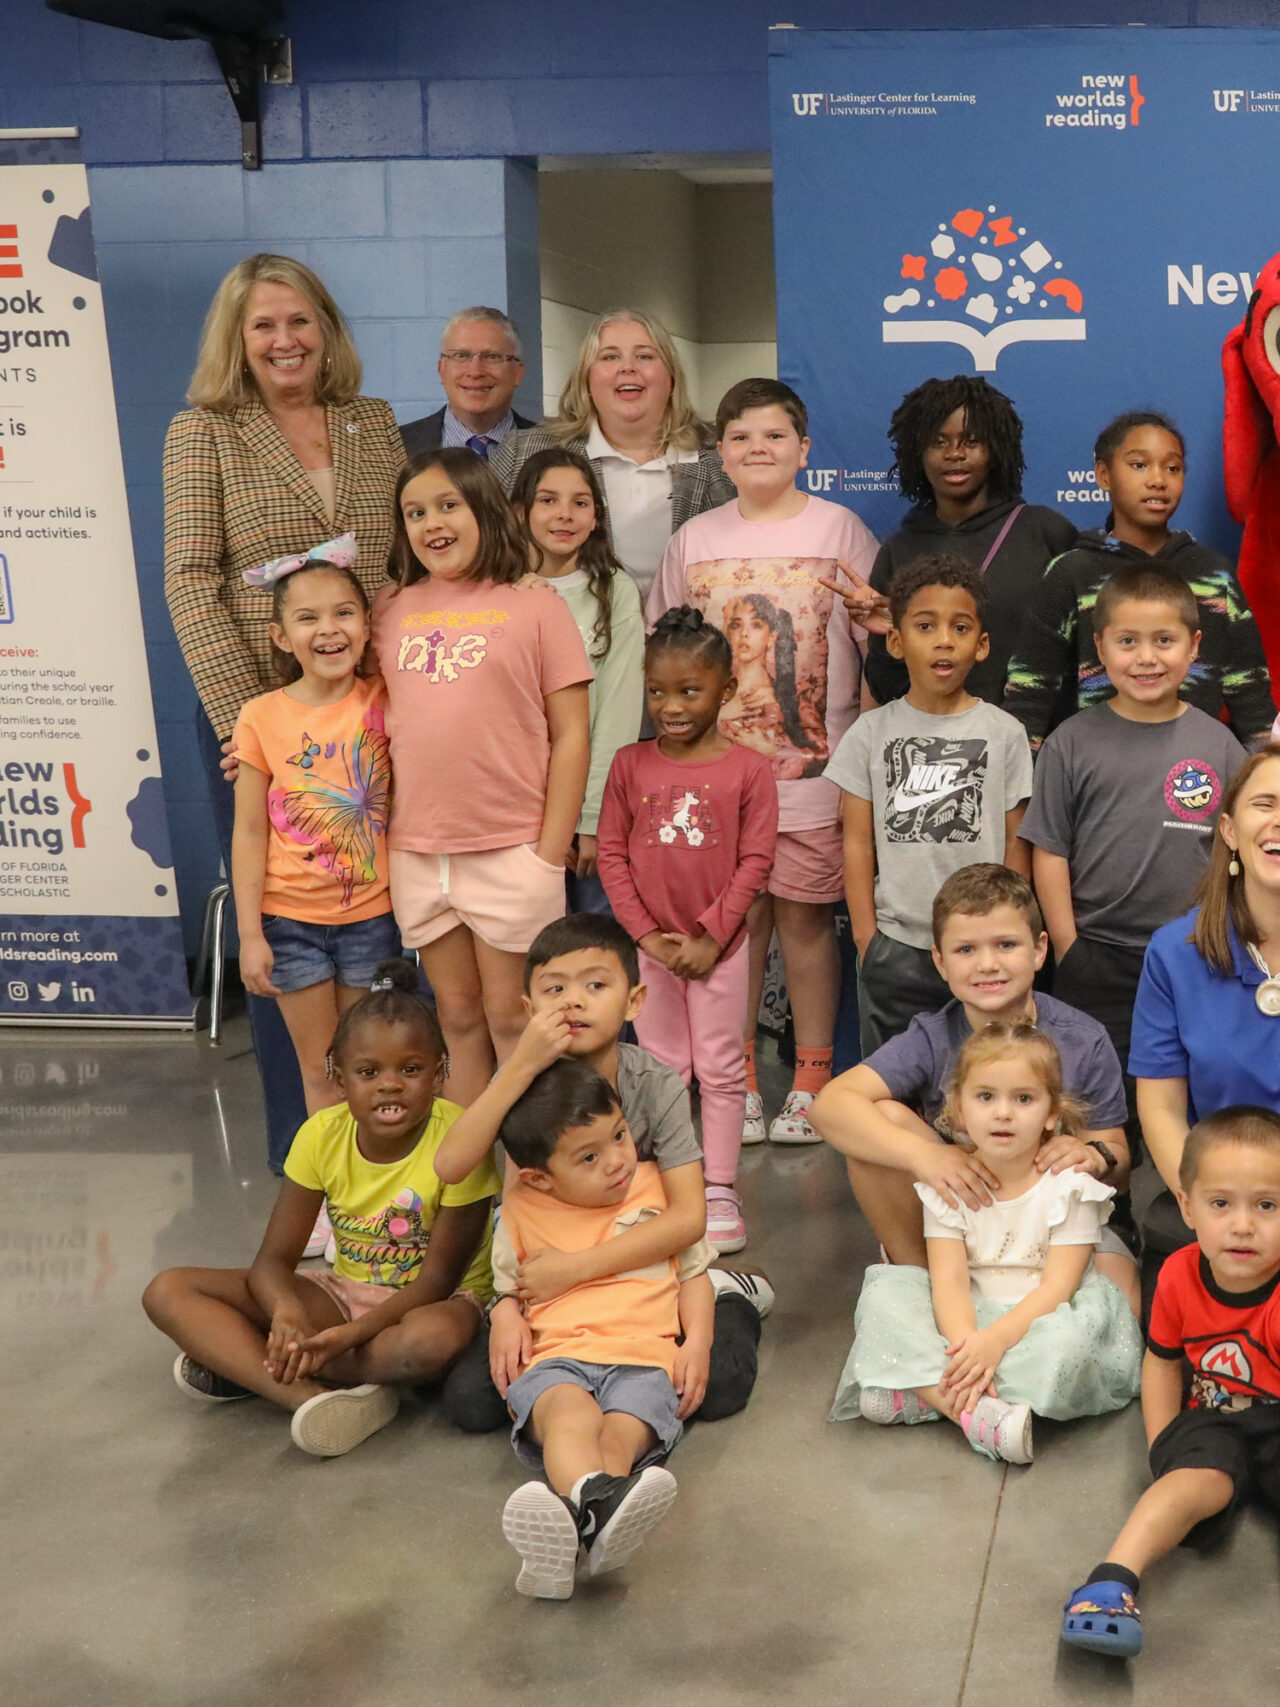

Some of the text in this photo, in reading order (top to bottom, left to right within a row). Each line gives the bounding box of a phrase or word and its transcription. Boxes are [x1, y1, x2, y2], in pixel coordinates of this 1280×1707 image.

[1082, 75, 1125, 88] new
[792, 94, 823, 116] UF
[830, 92, 976, 105] Lastinger Center for Learning
[1056, 90, 1126, 107] worlds
[1213, 90, 1244, 112] UF
[831, 106, 937, 117] UNIVERSITY of FLORIDA
[1045, 109, 1126, 130] reading
[9, 418, 27, 436] is
[806, 469, 838, 492] UF
[1057, 488, 1111, 503] readi
[4, 506, 97, 520] if your child is
[25, 527, 92, 539] activities.
[10, 668, 36, 677] their
[39, 668, 76, 678] unique
[31, 682, 49, 691] the
[52, 683, 87, 692] school
[89, 685, 114, 693] year
[25, 696, 64, 706] Creole,
[80, 696, 118, 706] braille.
[43, 717, 55, 725] to
[58, 717, 77, 725] use
[20, 729, 83, 740] confidence.
[0, 761, 53, 782] ew
[904, 764, 961, 791] NIKE
[1, 861, 67, 872] OF FLORIDA
[25, 875, 69, 885] CENTER
[21, 931, 60, 942] more
[63, 930, 81, 942] at
